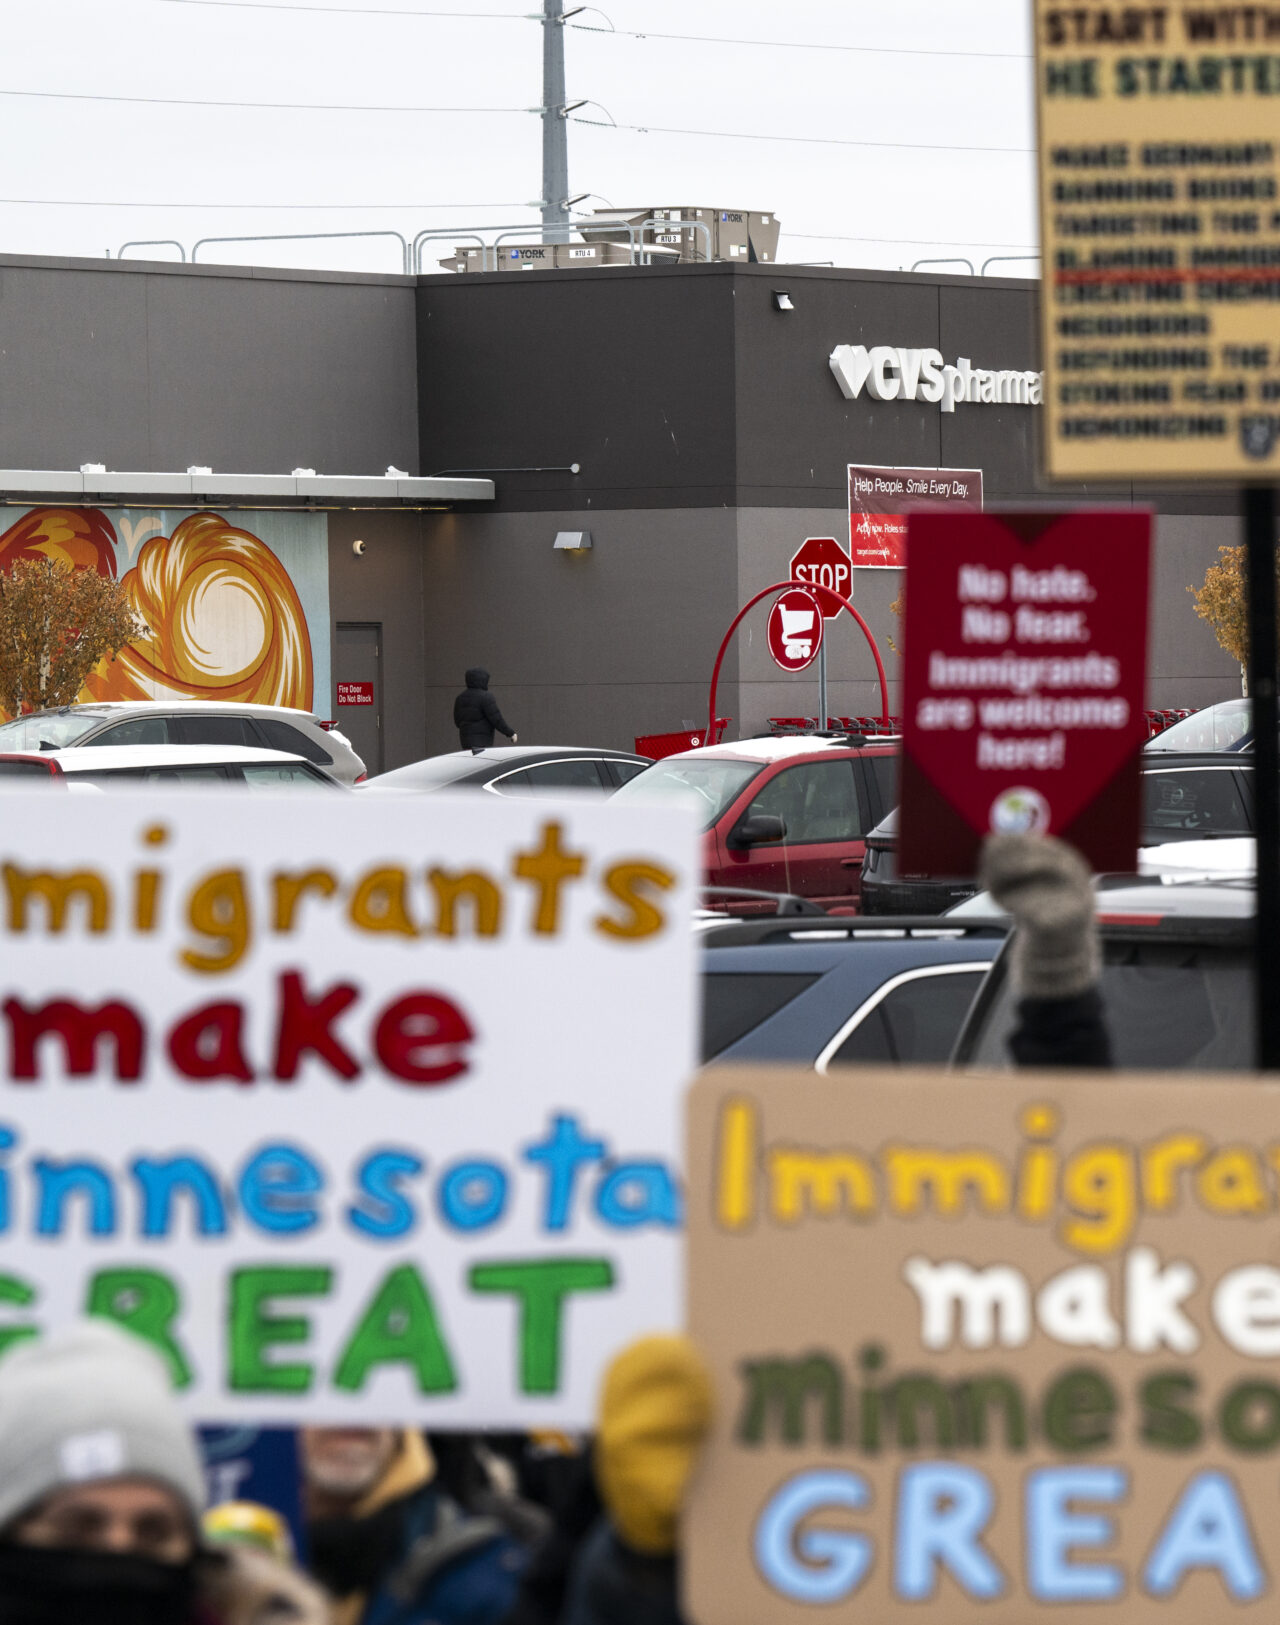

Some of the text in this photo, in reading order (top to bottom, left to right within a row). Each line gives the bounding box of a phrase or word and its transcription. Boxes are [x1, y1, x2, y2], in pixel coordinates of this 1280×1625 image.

[1045, 6, 1166, 45] START
[1045, 55, 1099, 97] HE
[1141, 143, 1273, 168] GERMANY
[727, 213, 743, 223] YORK
[1213, 211, 1259, 234] THE
[520, 249, 545, 259] YORK
[1221, 345, 1269, 369] THE
[866, 346, 945, 402] CVS
[855, 477, 969, 498] Help People. Smile Every Day.
[796, 564, 848, 593] STOP
[959, 564, 1096, 602] No hate.
[962, 604, 1090, 642] No fear.
[930, 651, 1120, 694] Immigrants
[338, 685, 362, 693] Fire Door
[338, 695, 346, 703] Do
[357, 694, 371, 702] Block
[917, 695, 1129, 729] are welcome
[977, 731, 1065, 769] here!
[0, 968, 476, 1087] make
